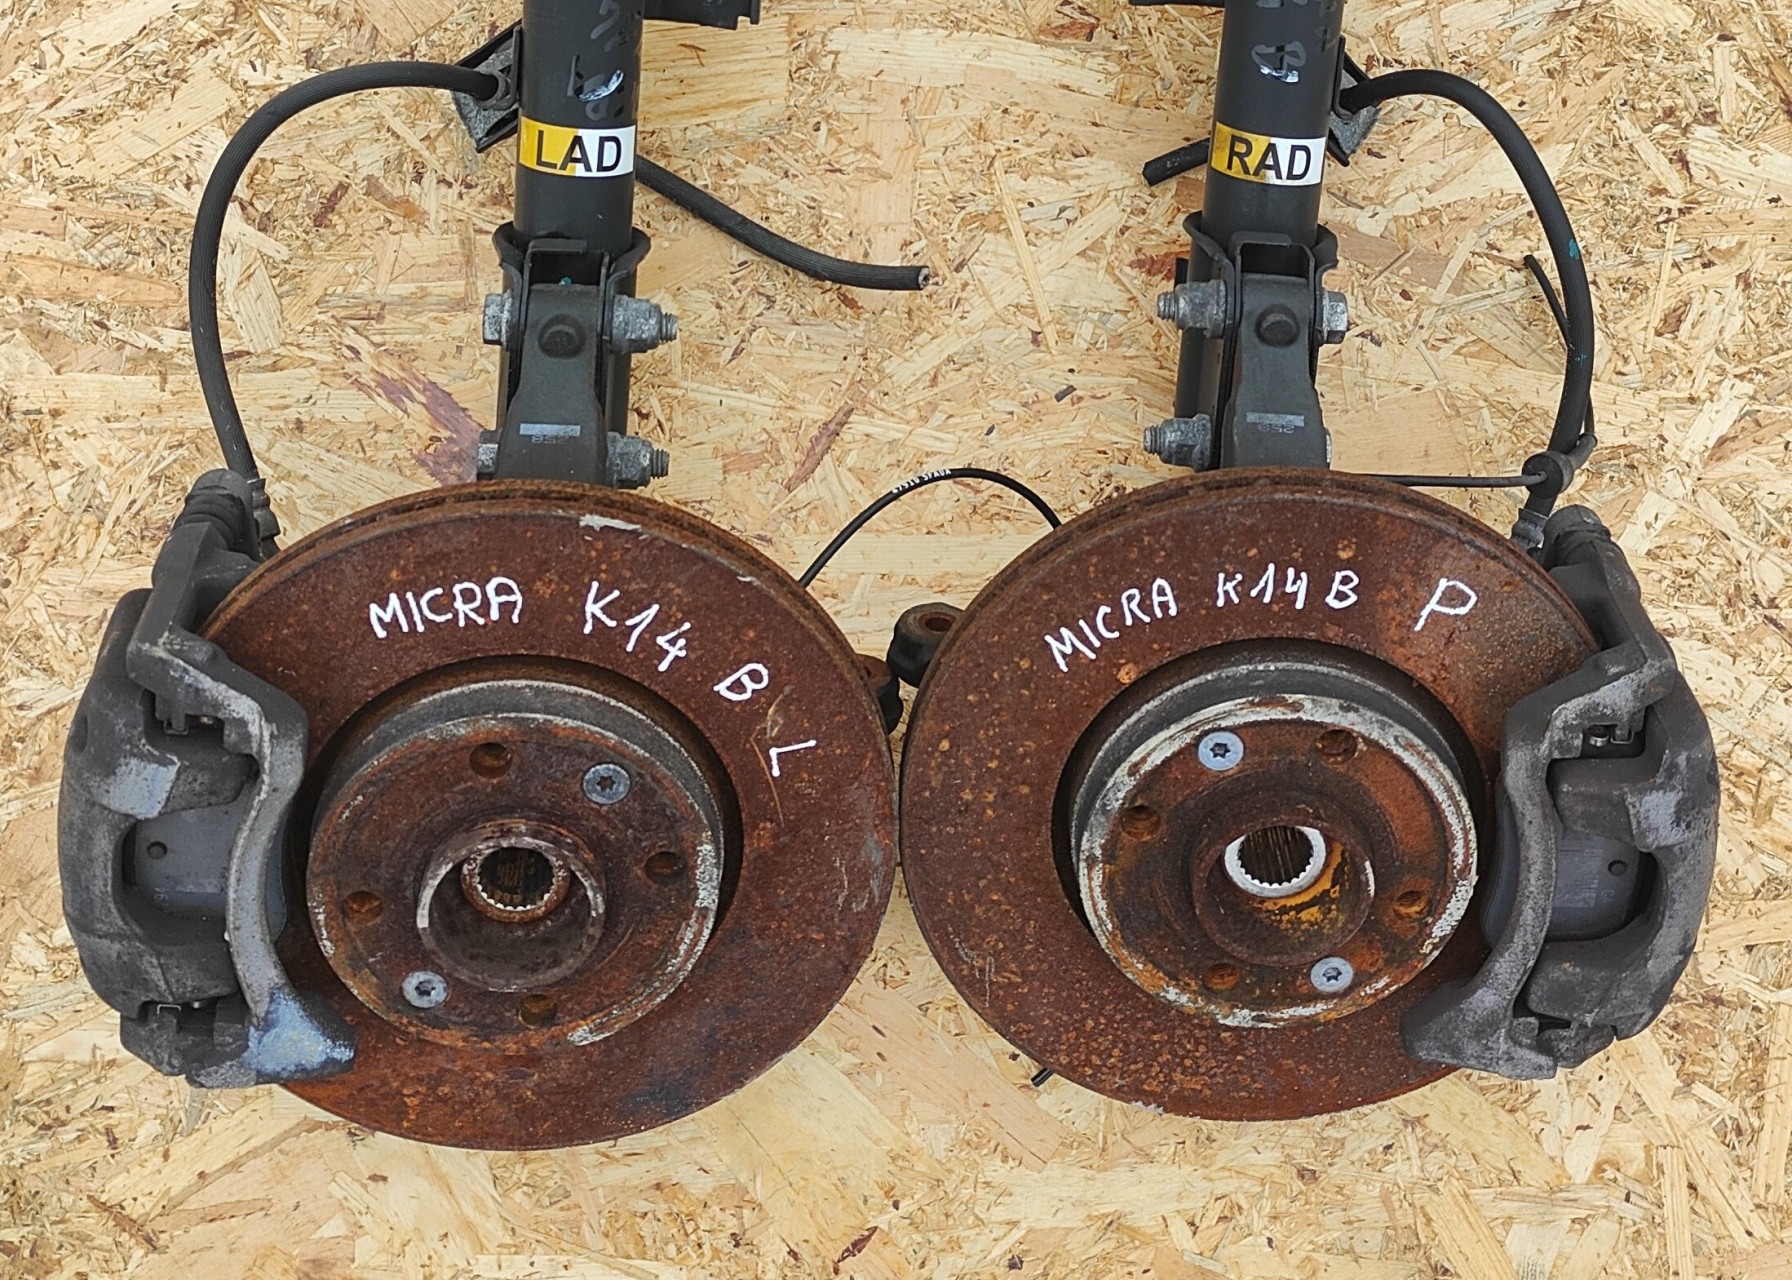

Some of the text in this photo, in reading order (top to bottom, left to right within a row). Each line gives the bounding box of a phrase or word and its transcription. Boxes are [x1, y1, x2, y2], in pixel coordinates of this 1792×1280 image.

[535, 129, 622, 173] LAD
[1227, 134, 1312, 181] RAD
[1044, 577, 1178, 673] MICRA
[1215, 563, 1308, 610] K14
[1414, 577, 1478, 631] P
[368, 575, 817, 778] MICRA K14 B L
